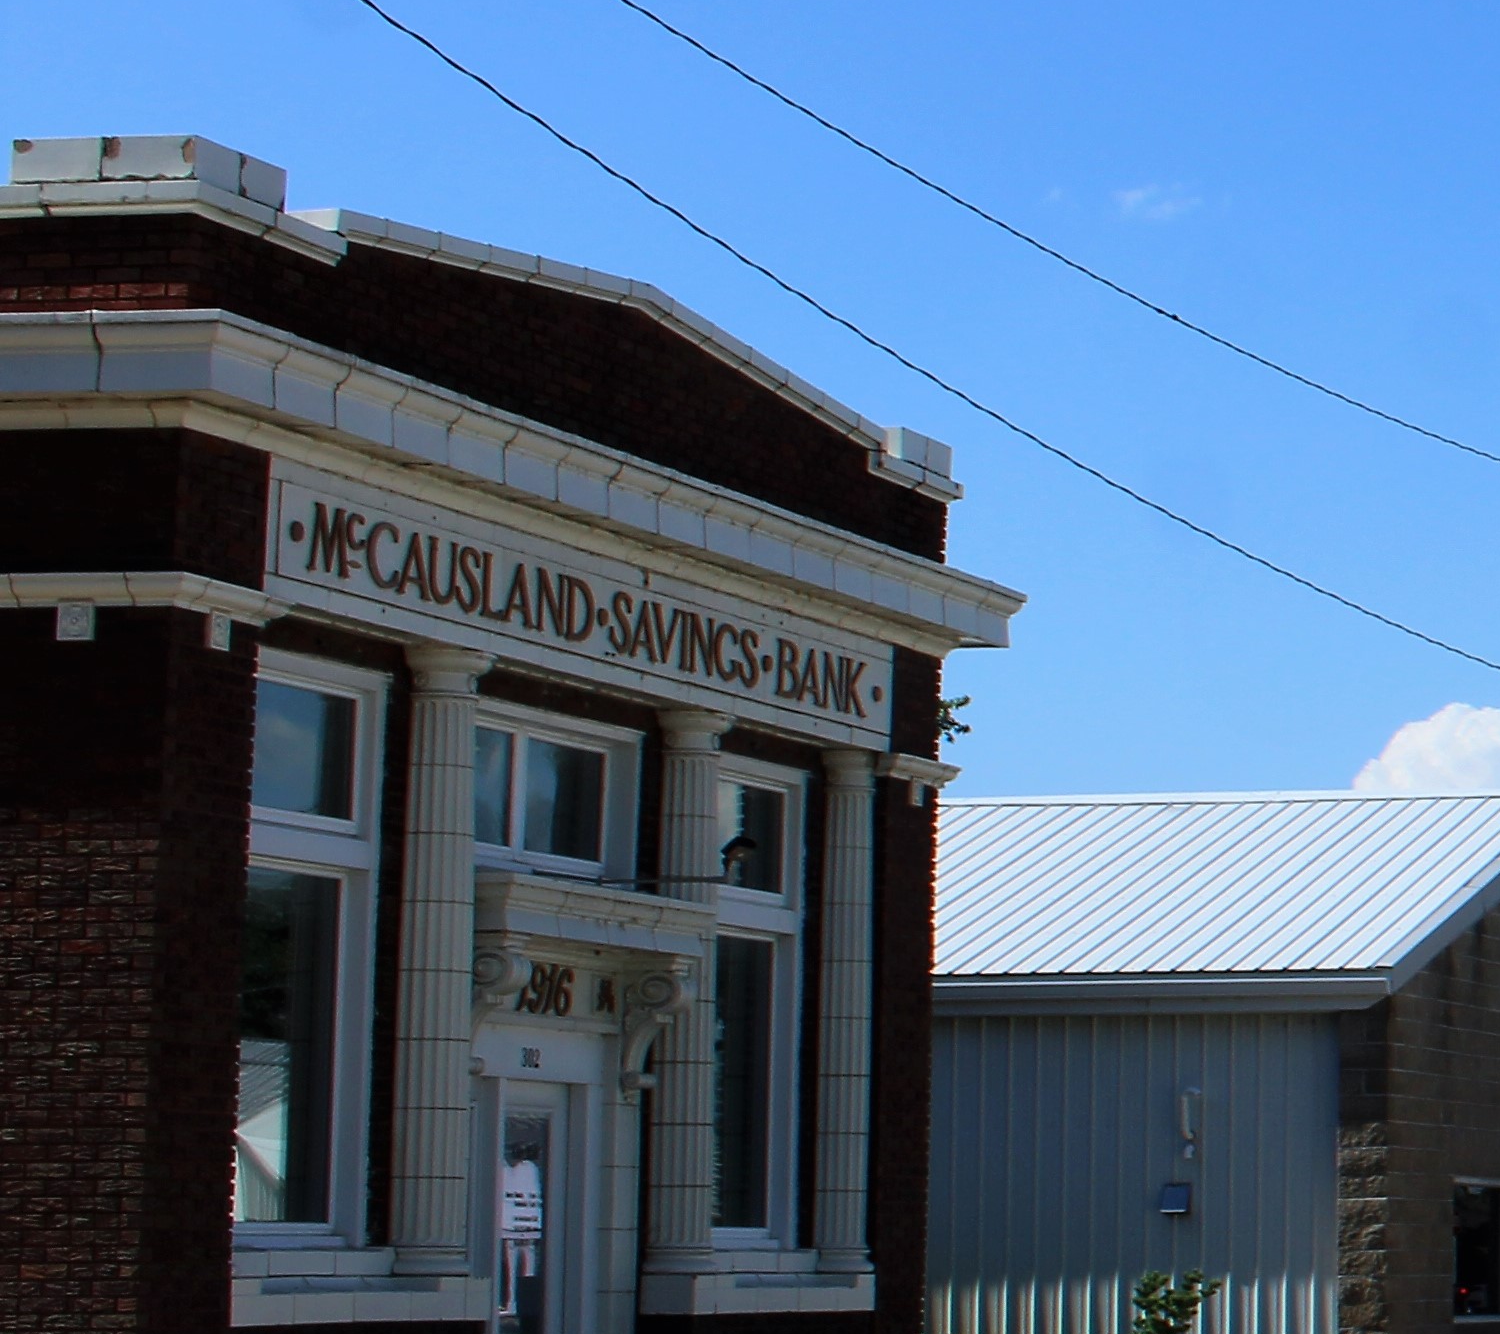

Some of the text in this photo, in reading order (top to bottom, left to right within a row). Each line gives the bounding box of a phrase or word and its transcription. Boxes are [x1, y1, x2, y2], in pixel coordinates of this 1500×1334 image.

[306, 501, 868, 718] McCAUSLAND SAVINGS BANK
